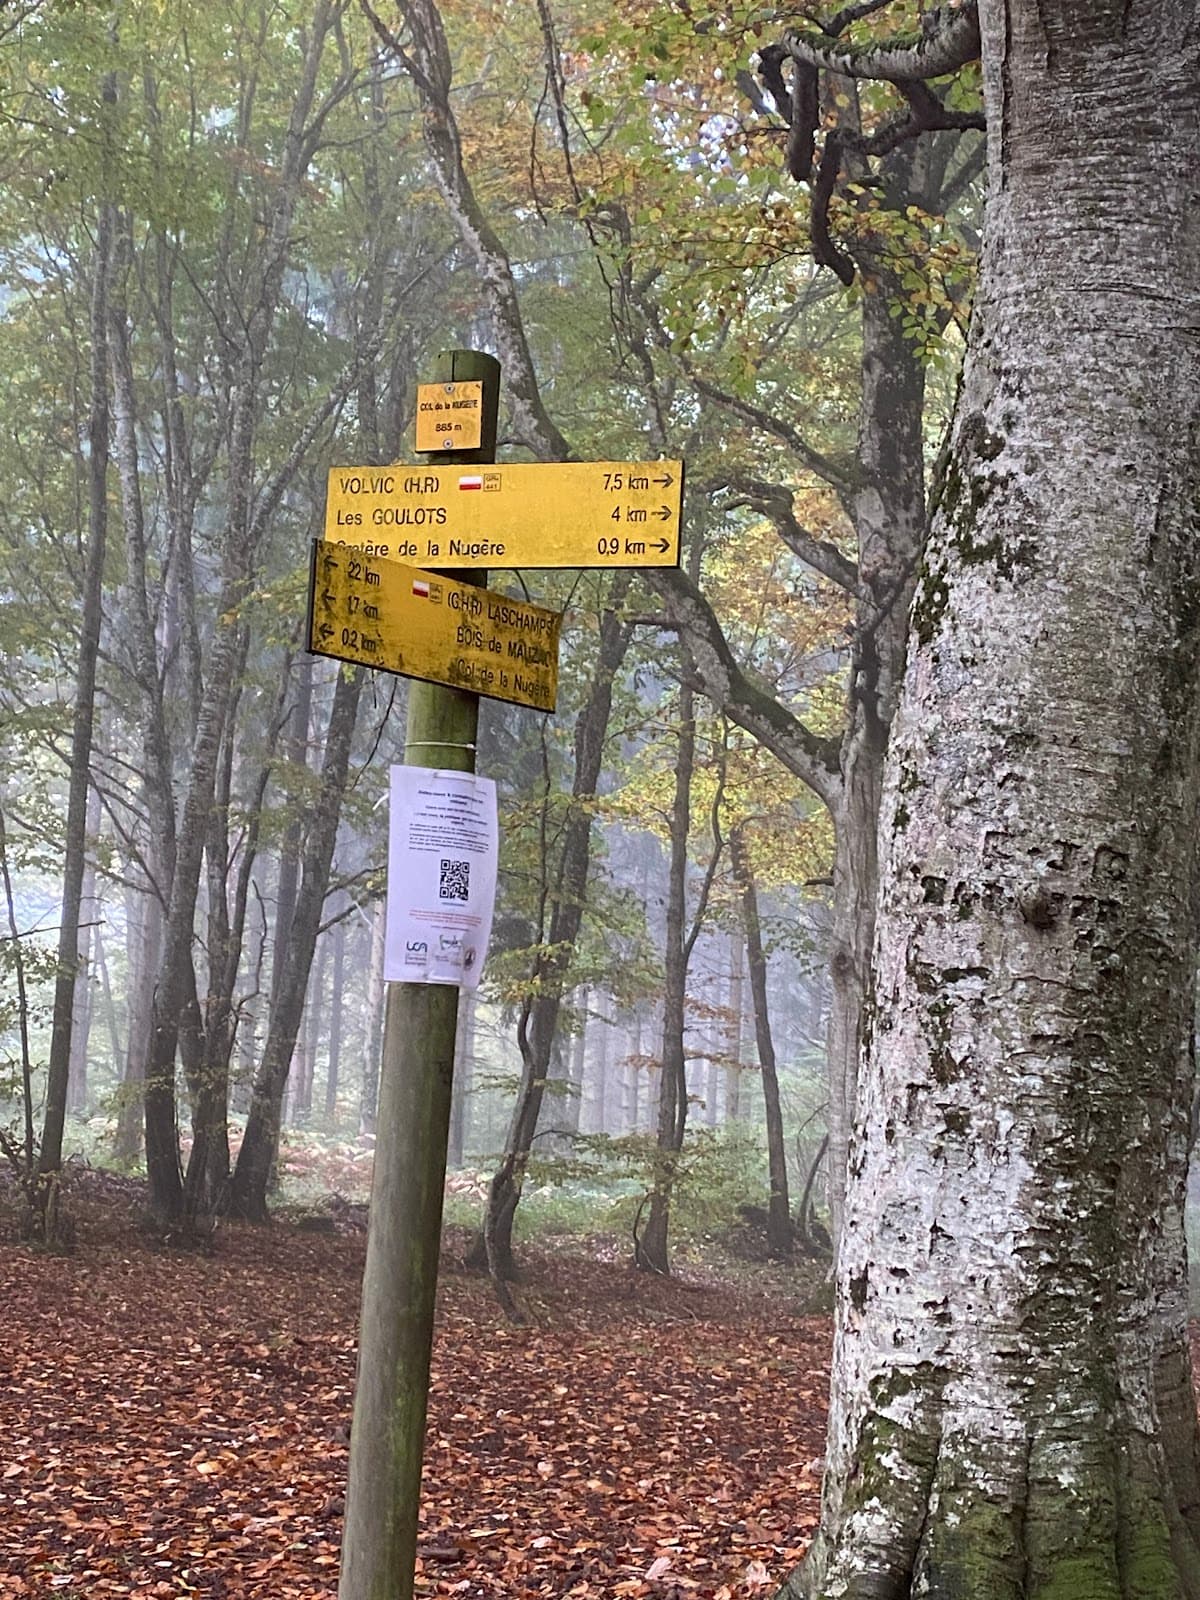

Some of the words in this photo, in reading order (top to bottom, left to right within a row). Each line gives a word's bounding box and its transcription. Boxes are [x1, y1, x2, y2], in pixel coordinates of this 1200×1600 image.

[340, 477, 395, 494] VOLVIC
[603, 474, 623, 492] 7,5
[628, 474, 649, 490] km
[337, 510, 362, 525] Les
[372, 508, 447, 525] GOULOTS
[611, 505, 621, 522] 4
[626, 505, 647, 522] km
[398, 540, 418, 556] de
[427, 540, 440, 556] la
[449, 539, 505, 559] Nugère
[597, 537, 619, 556] 0,9
[625, 538, 646, 554] km
[365, 565, 380, 586] km
[361, 633, 377, 653] km
[456, 626, 483, 648] BOIS
[488, 636, 502, 653] de
[458, 658, 475, 678] Col
[480, 666, 494, 684] de
[499, 669, 508, 688] la
